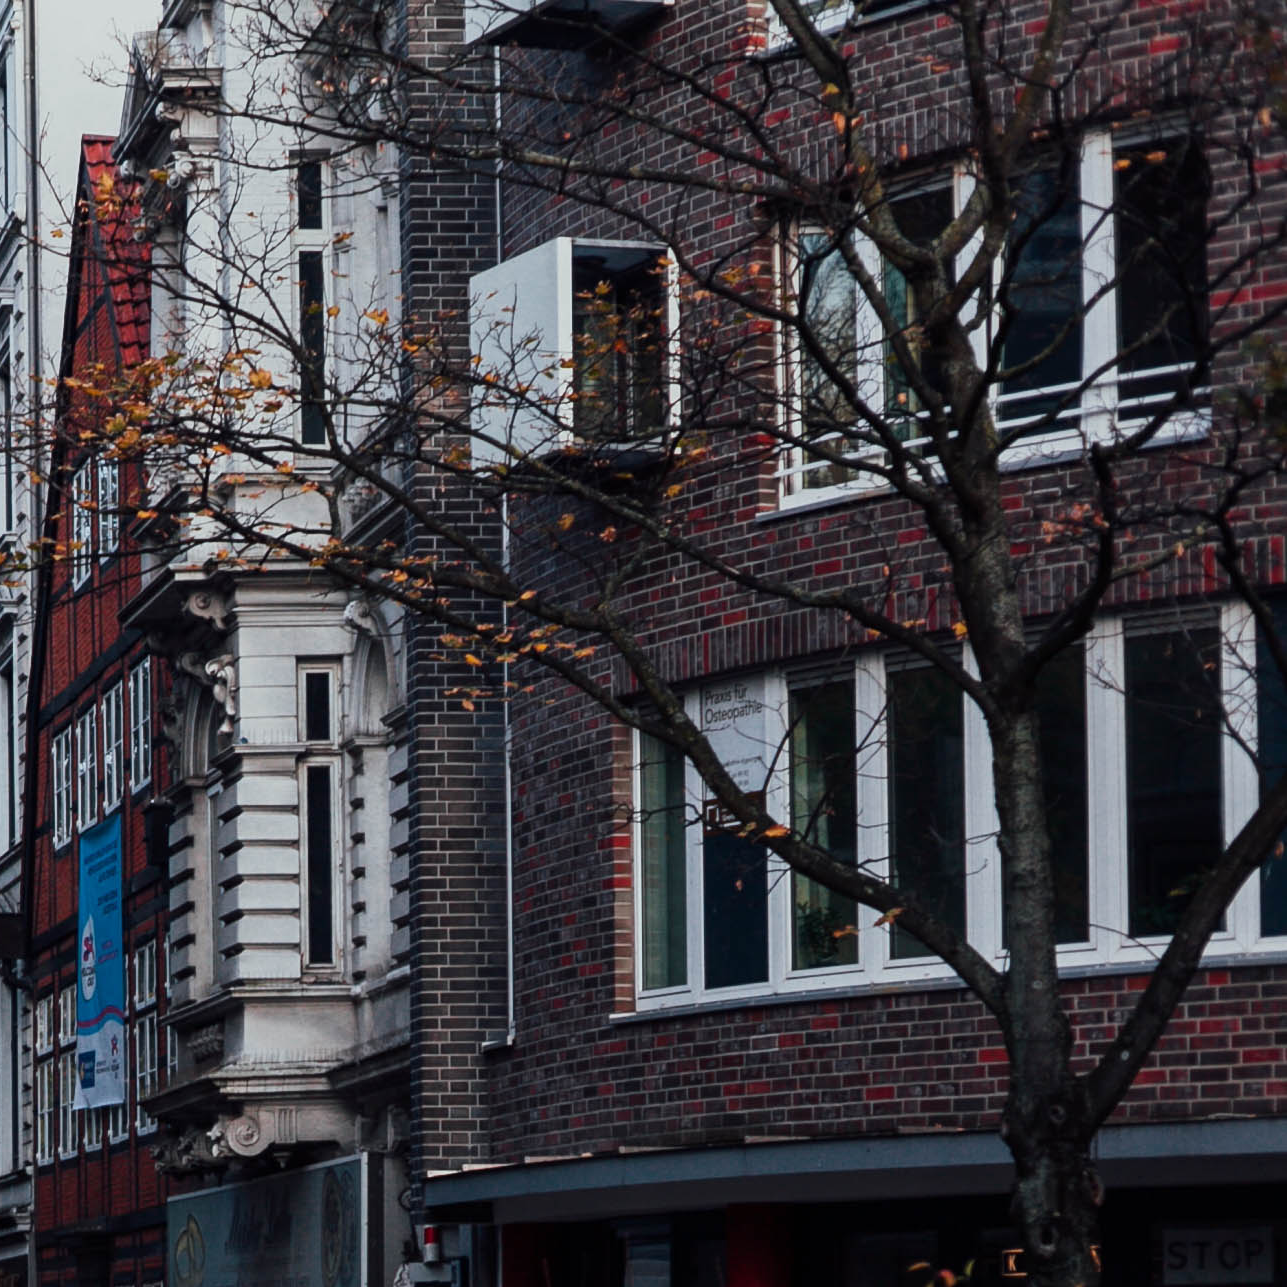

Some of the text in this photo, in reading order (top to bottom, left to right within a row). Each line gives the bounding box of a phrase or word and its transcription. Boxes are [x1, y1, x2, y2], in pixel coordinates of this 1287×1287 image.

[705, 689, 731, 705] Praxis
[705, 701, 763, 724] Osteopathie
[1166, 1239, 1265, 1271] STOP
